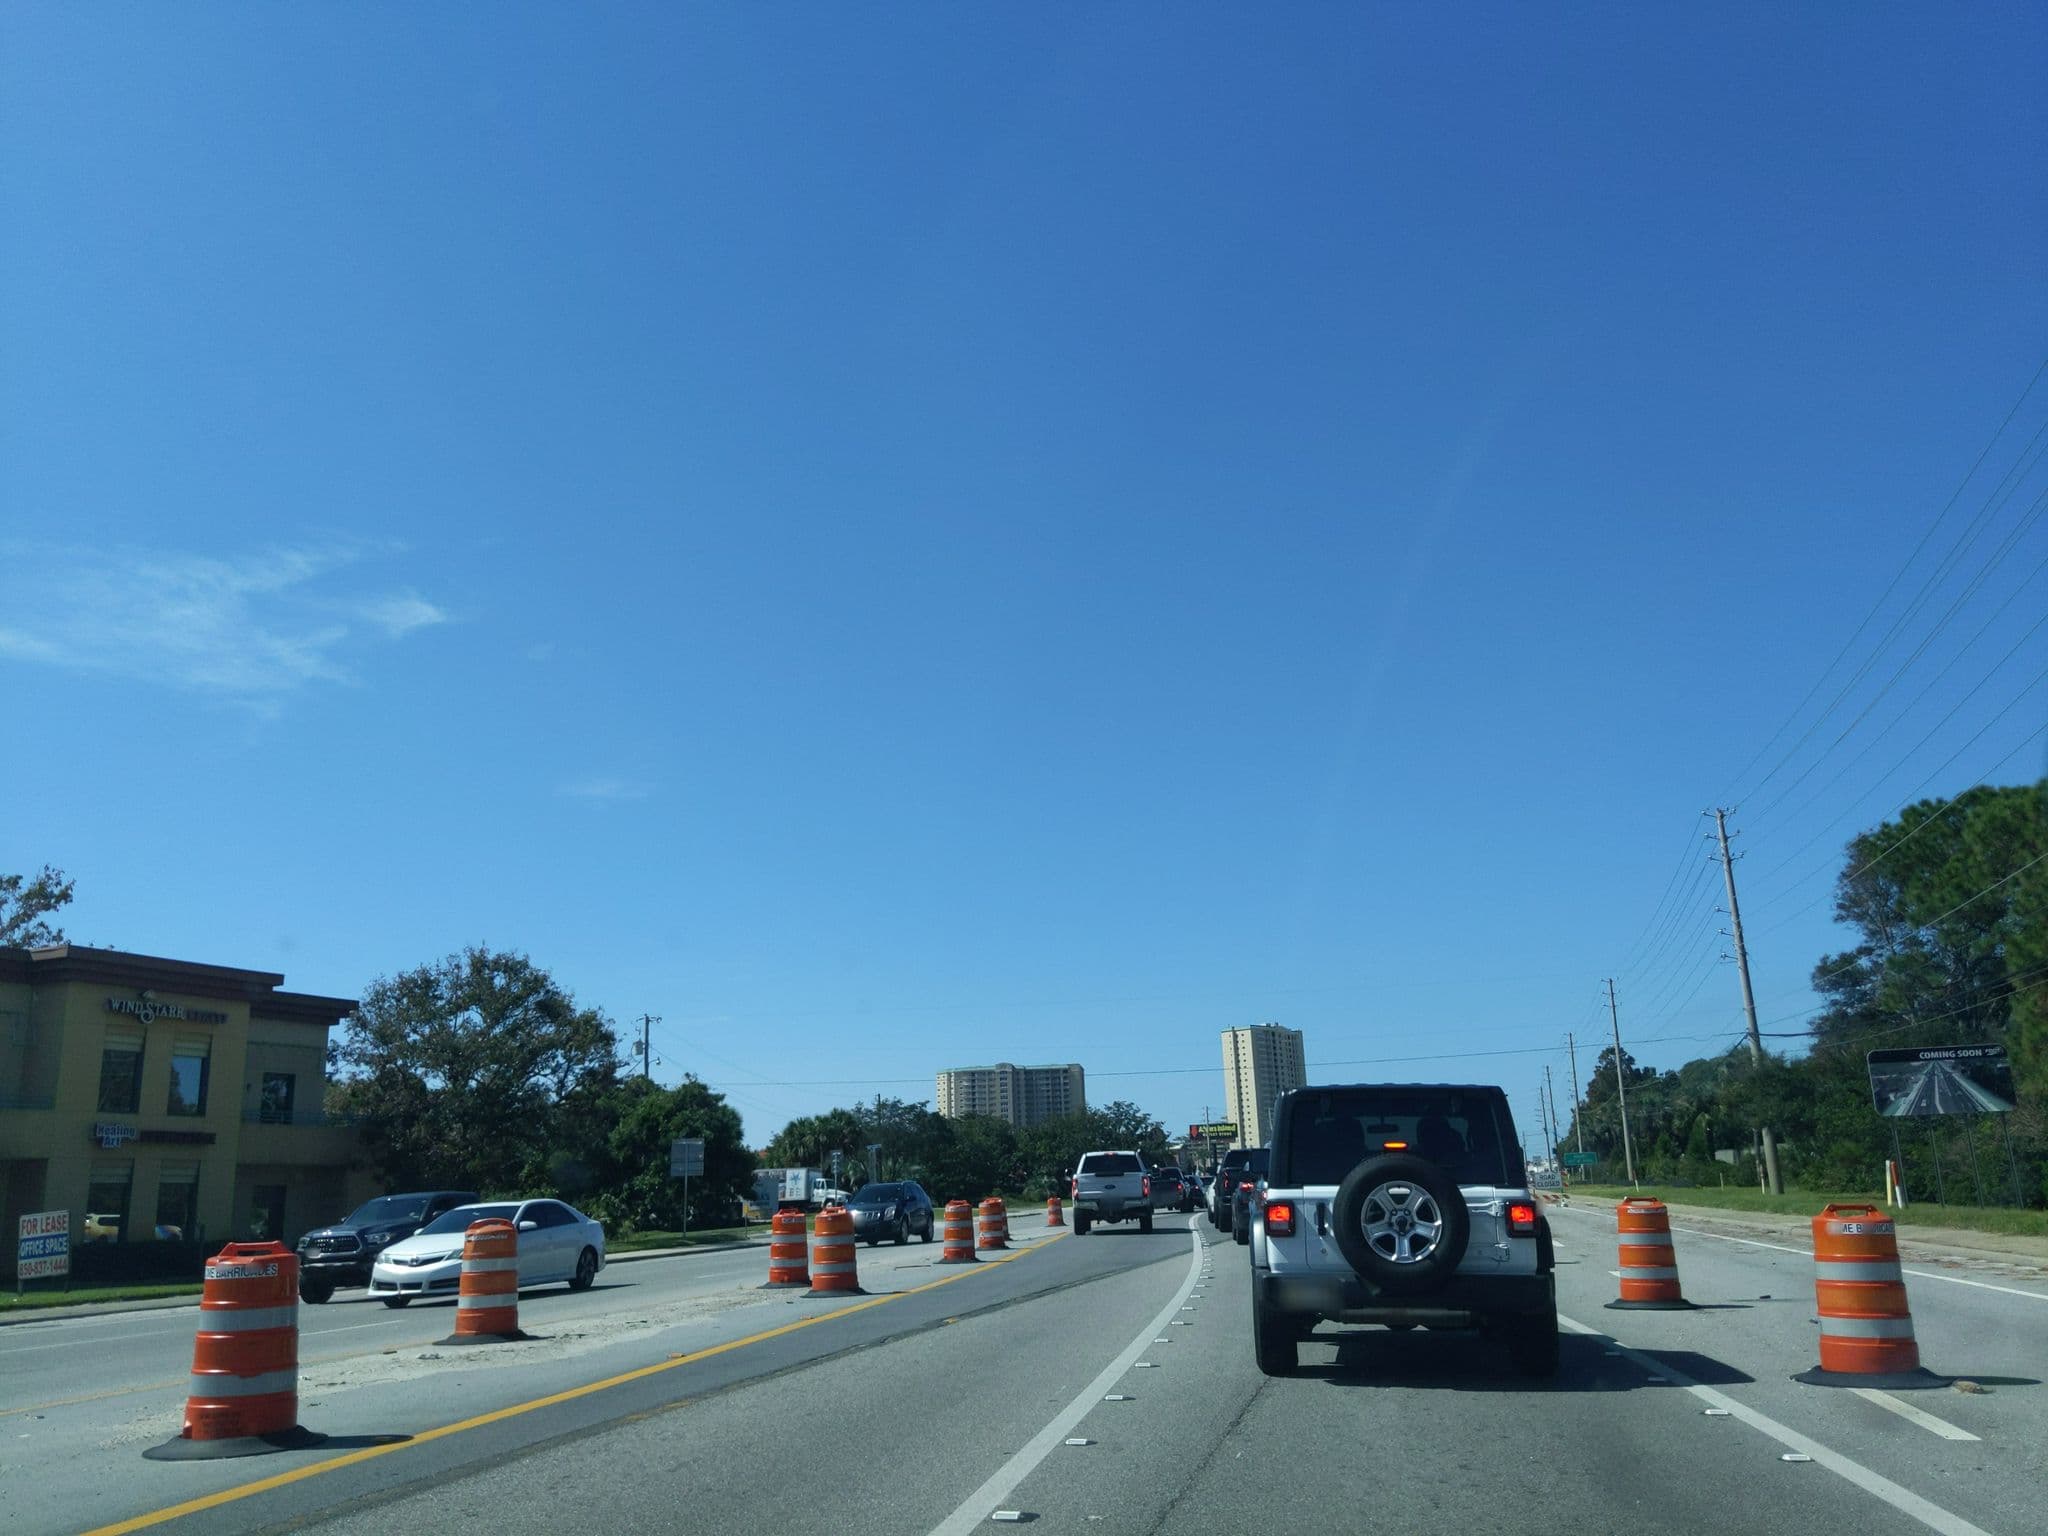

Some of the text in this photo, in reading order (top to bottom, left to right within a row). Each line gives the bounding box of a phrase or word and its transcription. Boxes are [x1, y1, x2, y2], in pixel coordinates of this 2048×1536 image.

[1919, 1050, 1955, 1060] COMING
[1957, 1049, 1982, 1057] SOON
[21, 1214, 67, 1235] FOR LEASE
[20, 1236, 67, 1257] OFFICE SPACE
